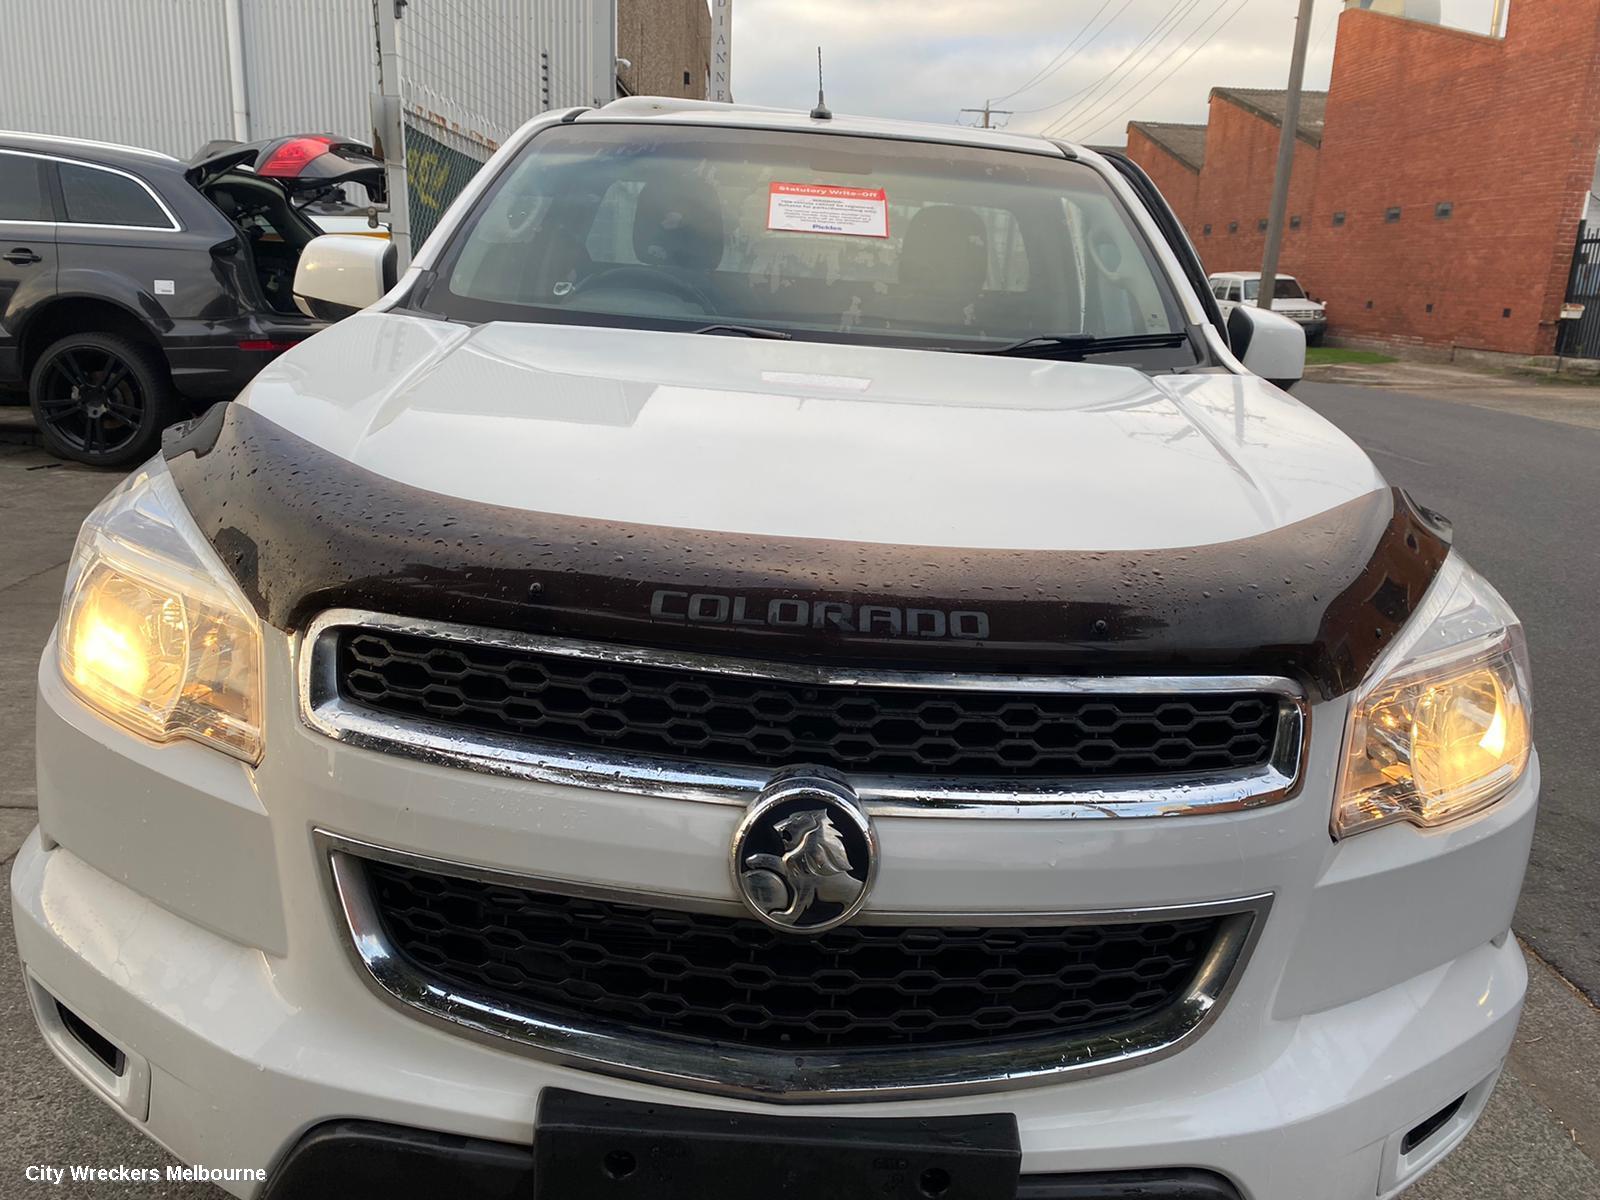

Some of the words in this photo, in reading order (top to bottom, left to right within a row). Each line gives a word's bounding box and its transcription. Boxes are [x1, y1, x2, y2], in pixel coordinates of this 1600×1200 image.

[778, 185, 827, 194] Statutory
[829, 187, 878, 197] Write-Off
[650, 589, 990, 639] COLORADO
